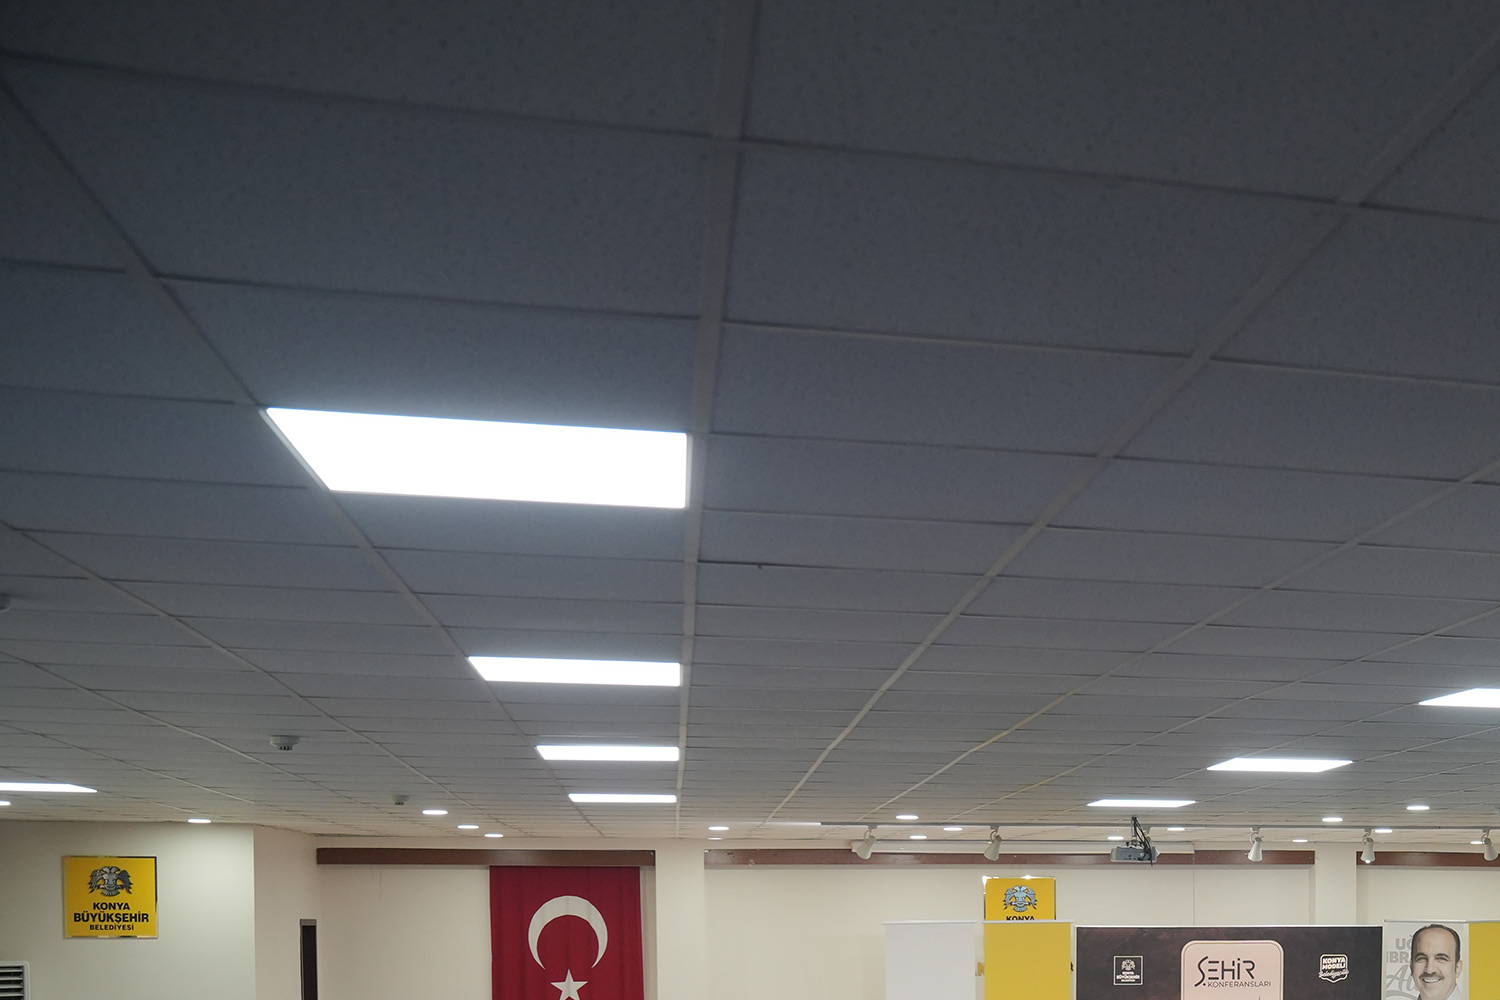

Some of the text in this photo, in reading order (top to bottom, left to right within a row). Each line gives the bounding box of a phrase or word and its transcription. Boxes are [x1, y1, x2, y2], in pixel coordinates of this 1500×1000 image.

[93, 902, 130, 911] KONYA
[73, 911, 149, 923] BÜYÜKŞEHİR
[1194, 956, 1255, 987] ŞEHİR
[1207, 980, 1272, 988] KONFERANSLARI
